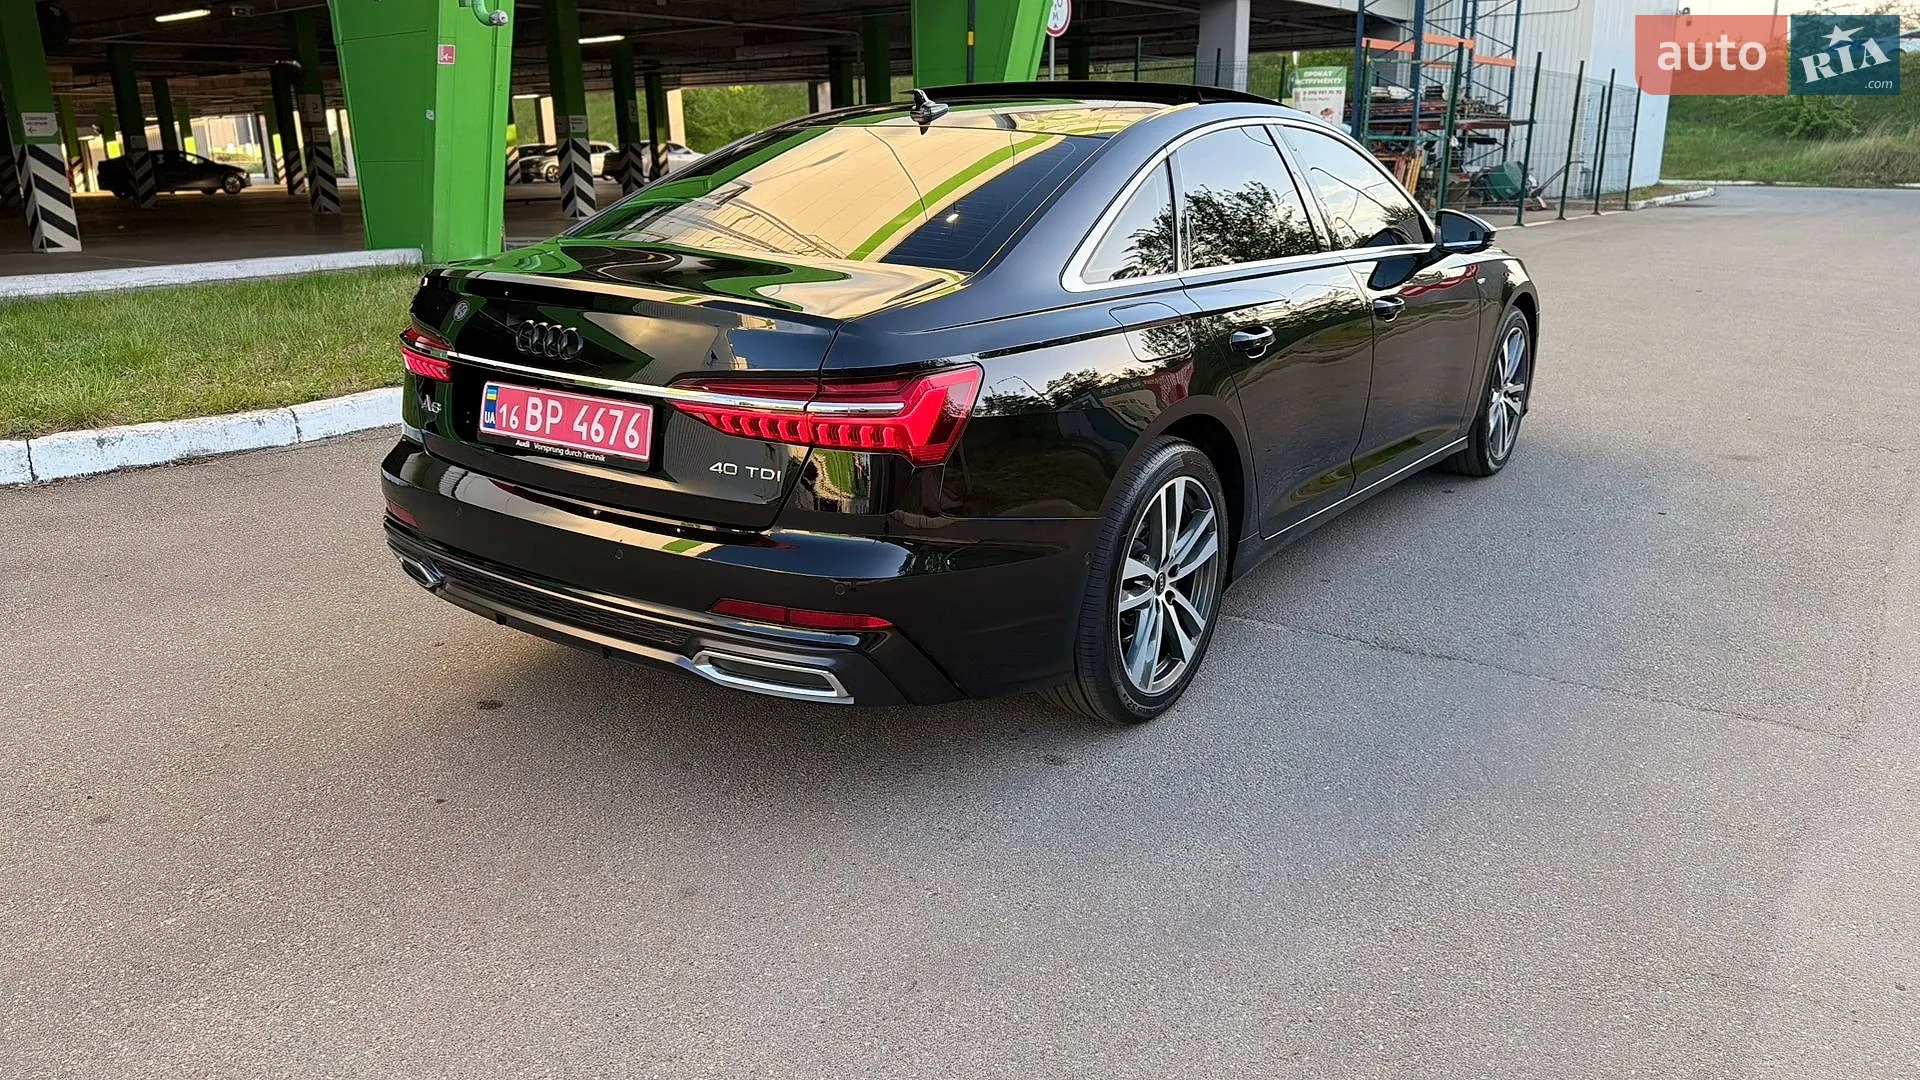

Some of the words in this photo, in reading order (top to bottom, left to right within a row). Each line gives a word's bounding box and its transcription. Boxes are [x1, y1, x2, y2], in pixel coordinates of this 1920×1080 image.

[421, 394, 442, 413] A6
[484, 411, 496, 424] UA
[499, 403, 520, 430] 16
[525, 396, 563, 435] BP
[572, 404, 642, 449] 4676
[515, 440, 530, 448] Audi
[533, 443, 564, 456] Vorsprung
[564, 448, 582, 458] durch
[583, 451, 606, 462] Technik
[709, 462, 738, 475] 40
[745, 466, 782, 482] TDI
